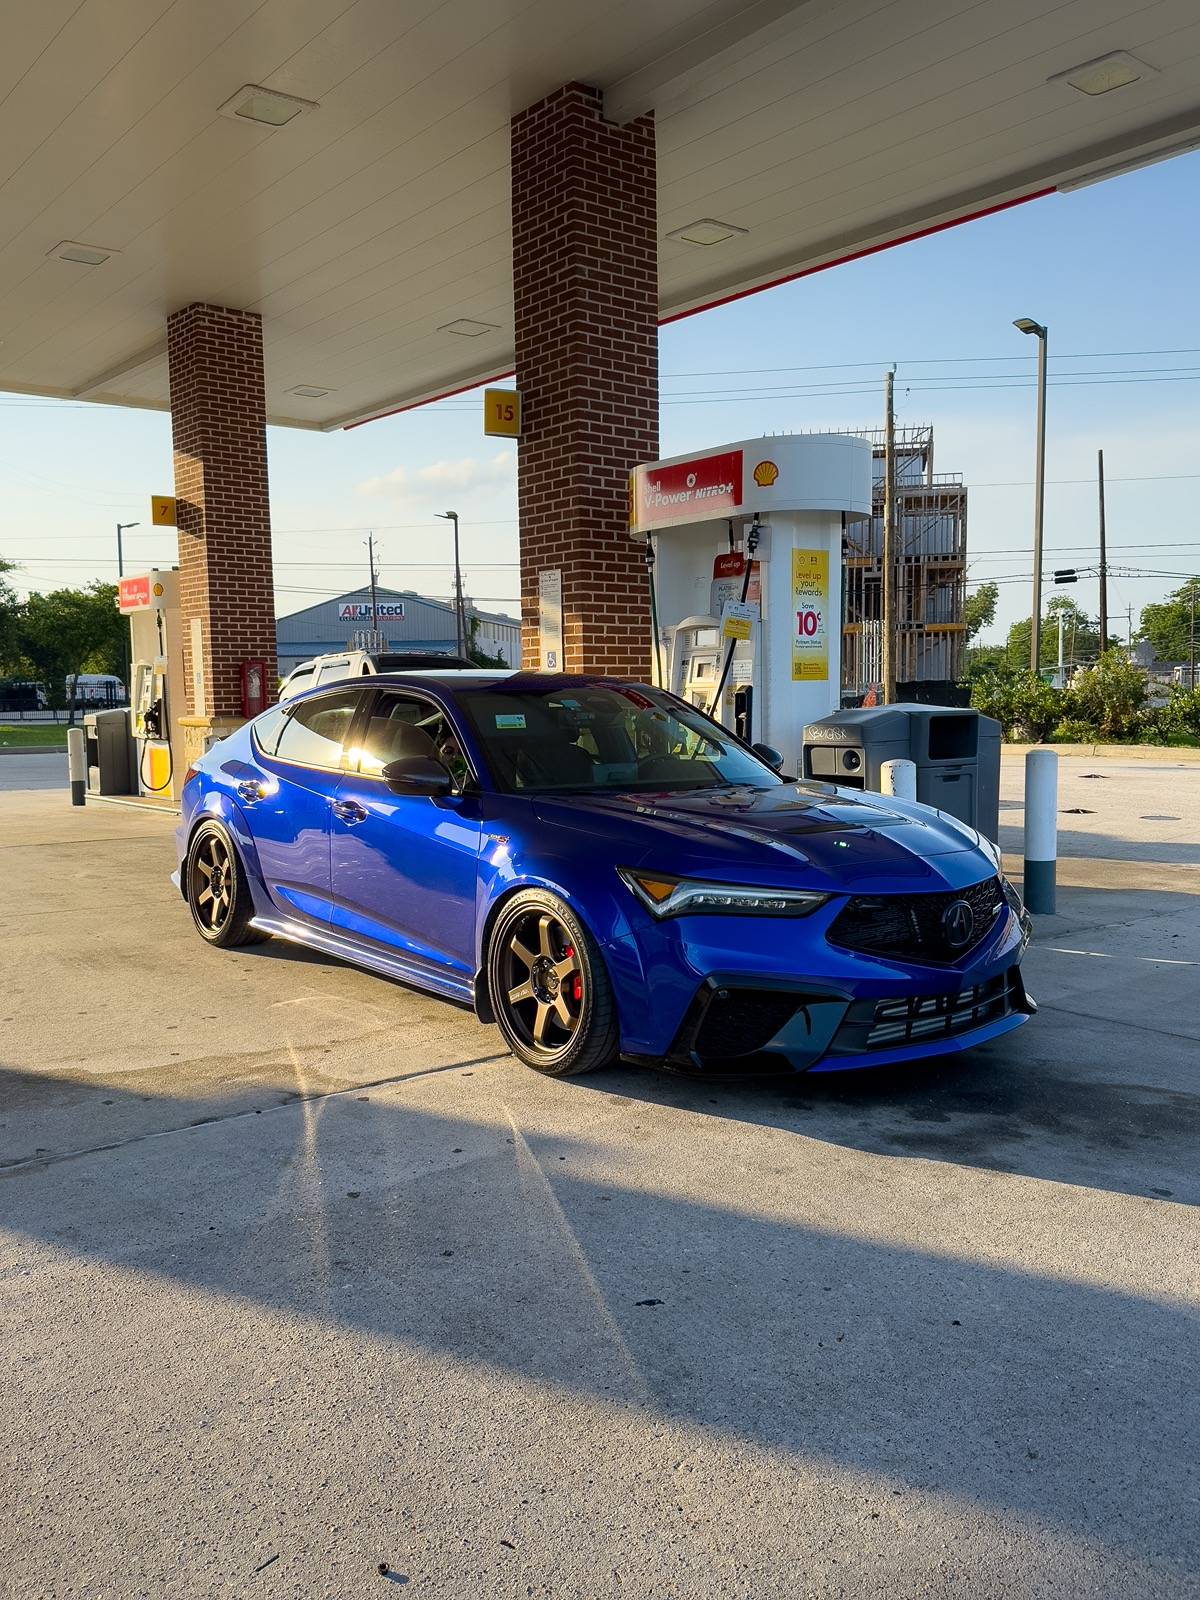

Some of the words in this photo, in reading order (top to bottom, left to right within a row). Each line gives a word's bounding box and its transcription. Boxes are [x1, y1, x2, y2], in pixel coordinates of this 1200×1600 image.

[496, 404, 514, 421] 15
[644, 491, 692, 508] V-Power
[160, 505, 169, 516] 7
[796, 570, 811, 579] Level
[812, 573, 822, 582] up
[800, 580, 816, 589] your
[801, 601, 815, 610] Save
